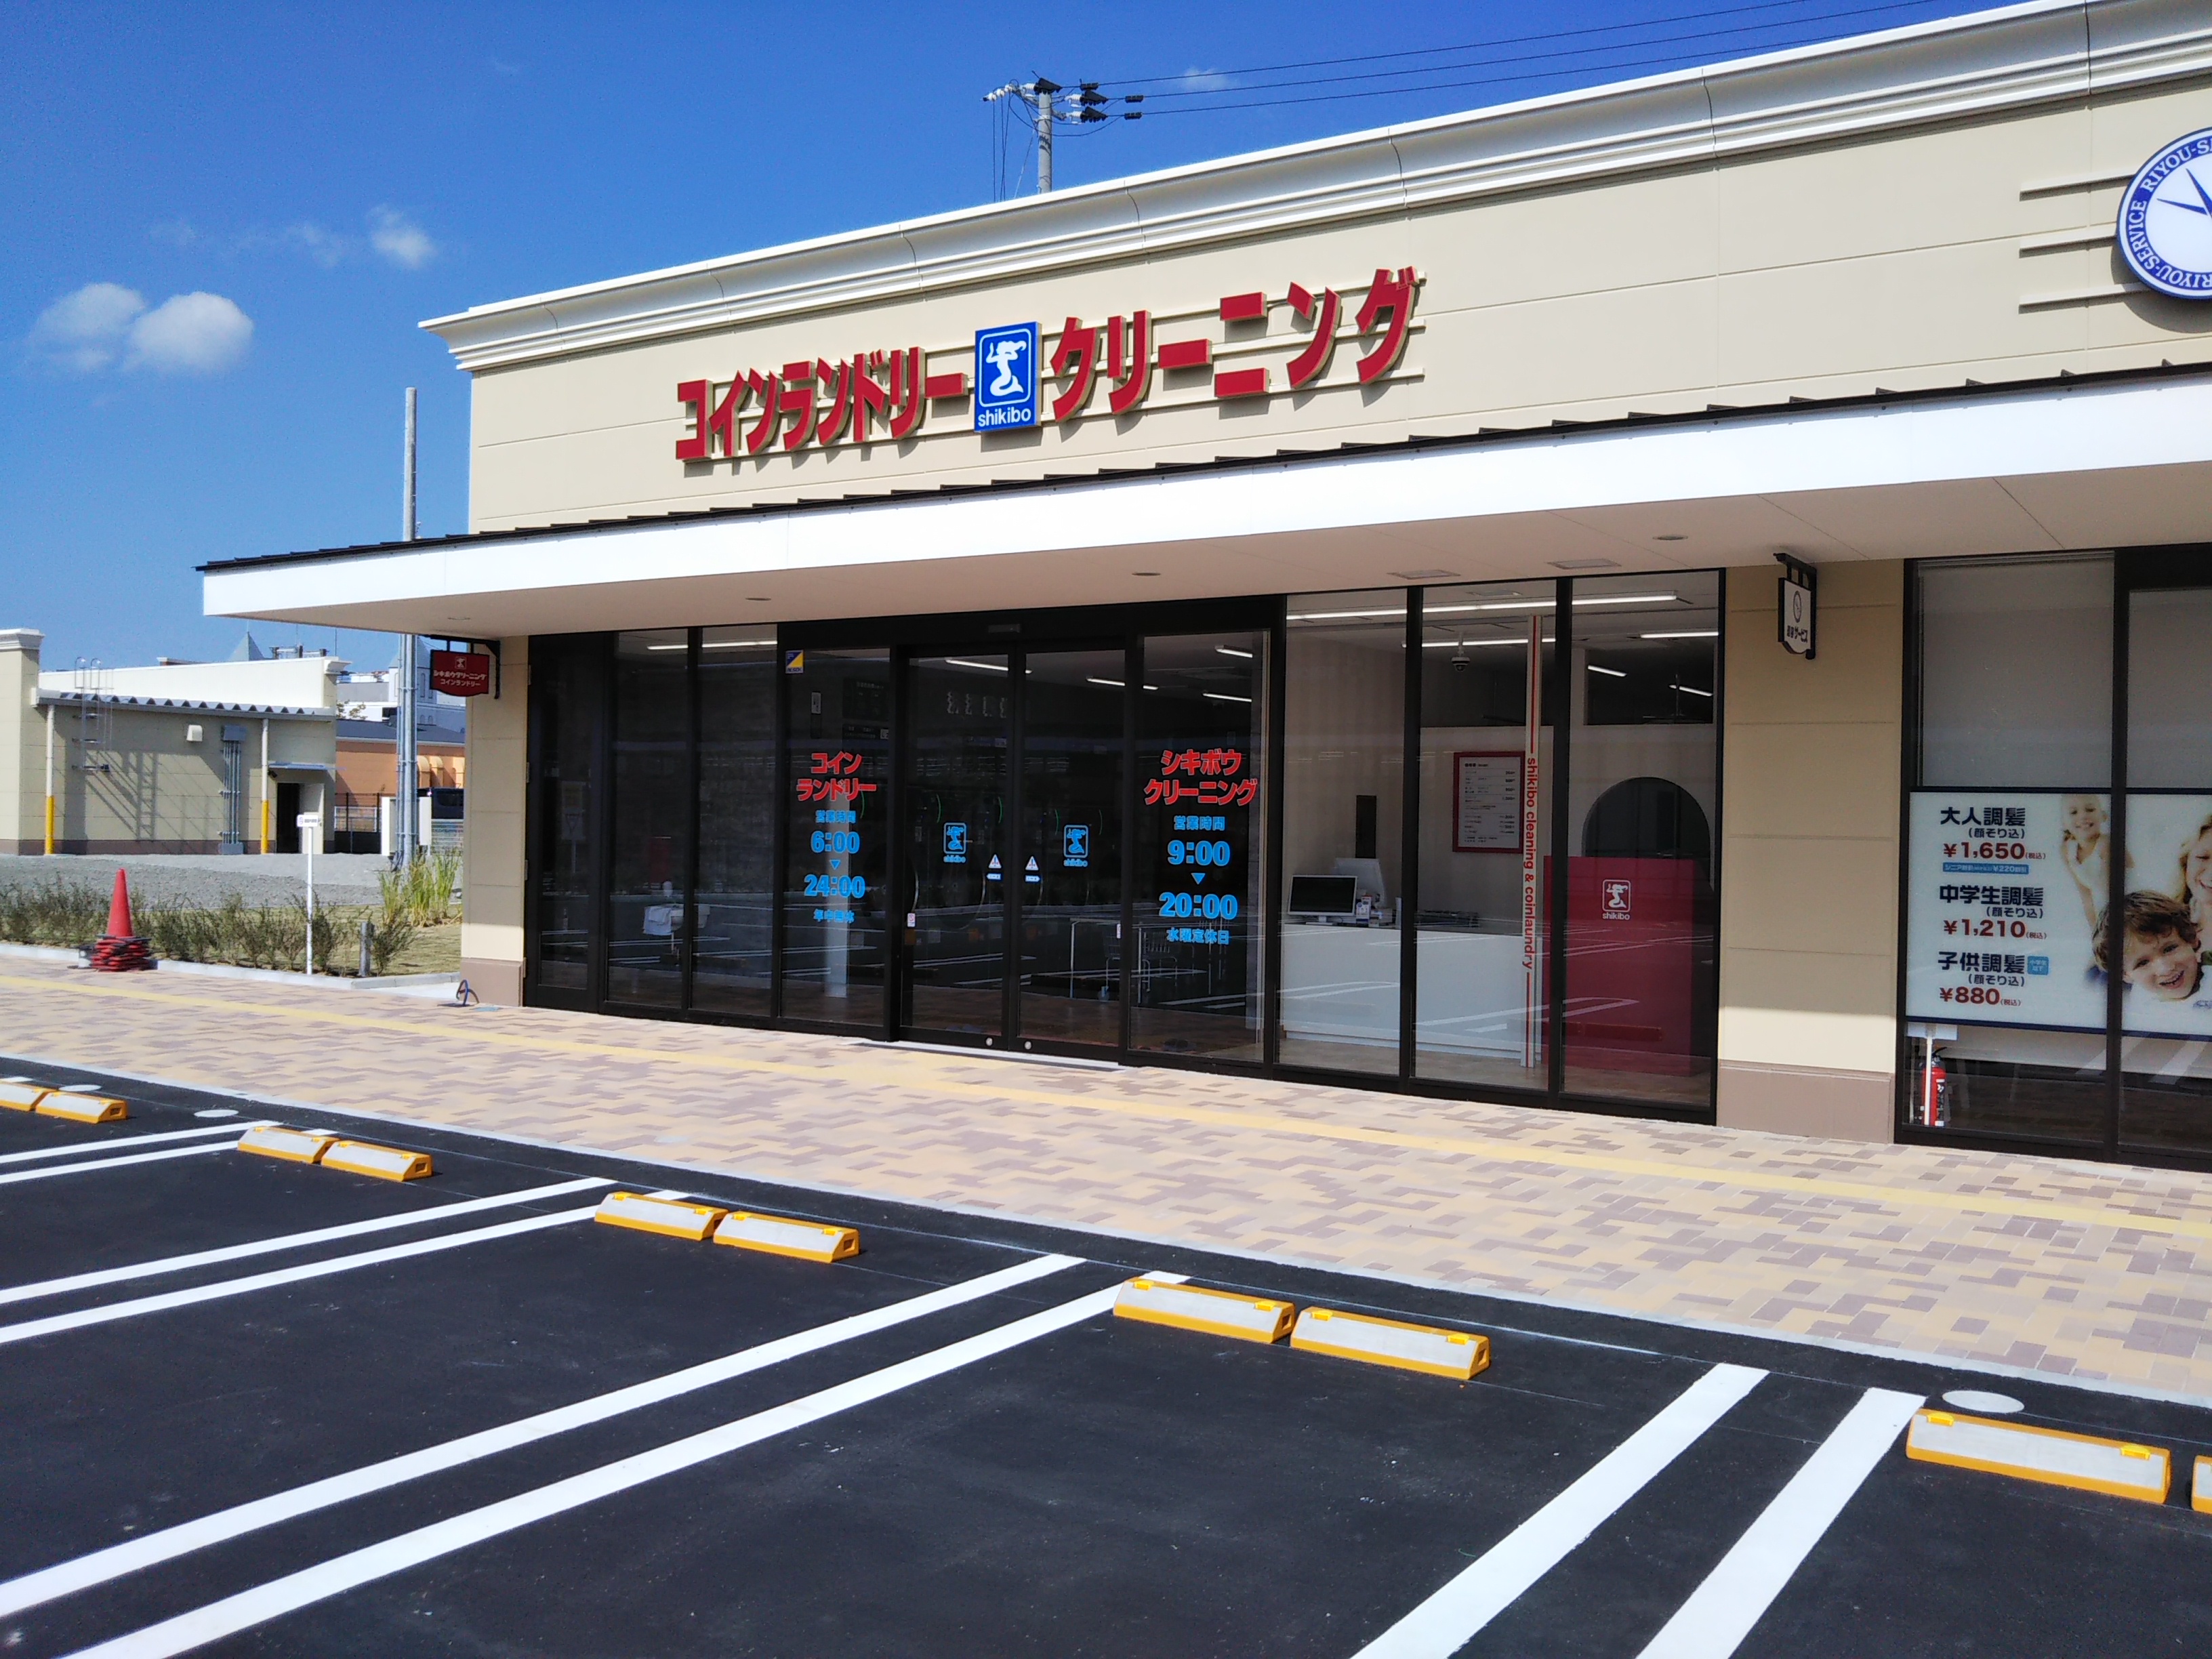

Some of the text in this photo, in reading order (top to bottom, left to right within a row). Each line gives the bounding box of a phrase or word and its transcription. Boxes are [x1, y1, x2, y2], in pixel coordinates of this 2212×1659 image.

[676, 266, 1418, 460] コインランドリー クリーニング
[977, 405, 1032, 430] shikibo
[433, 670, 488, 680] シキボウクリーニング
[441, 679, 480, 687] コインランドリー
[811, 750, 862, 775] コイン
[1160, 747, 1242, 776] シキボウ
[796, 777, 877, 802] ランドリー
[1143, 778, 1258, 806] クリーニング
[815, 810, 856, 824] 営業時間
[1173, 815, 1225, 831] 営業時間
[1940, 806, 2026, 827] 大人調髪
[811, 830, 860, 854] 6:00
[1968, 827, 2025, 839] (顔そり込)
[1167, 840, 1231, 867] 9:00
[1943, 842, 2026, 860] ¥1,650
[1522, 757, 1538, 970] shikibo cleaning & coinlaundry
[804, 874, 866, 899] 24:00
[1940, 884, 2044, 907] 中学生調髪
[1158, 891, 1238, 920] 20:00
[1602, 912, 1631, 920] shikibo
[1986, 906, 2043, 919] (顔そり込)
[1166, 927, 1229, 945] 水曜定休日
[1943, 918, 2026, 938] ¥1,210
[1938, 951, 2025, 975] 子供調髪
[1968, 974, 2025, 987] (顔そり込)
[1939, 986, 2000, 1005] ¥880
